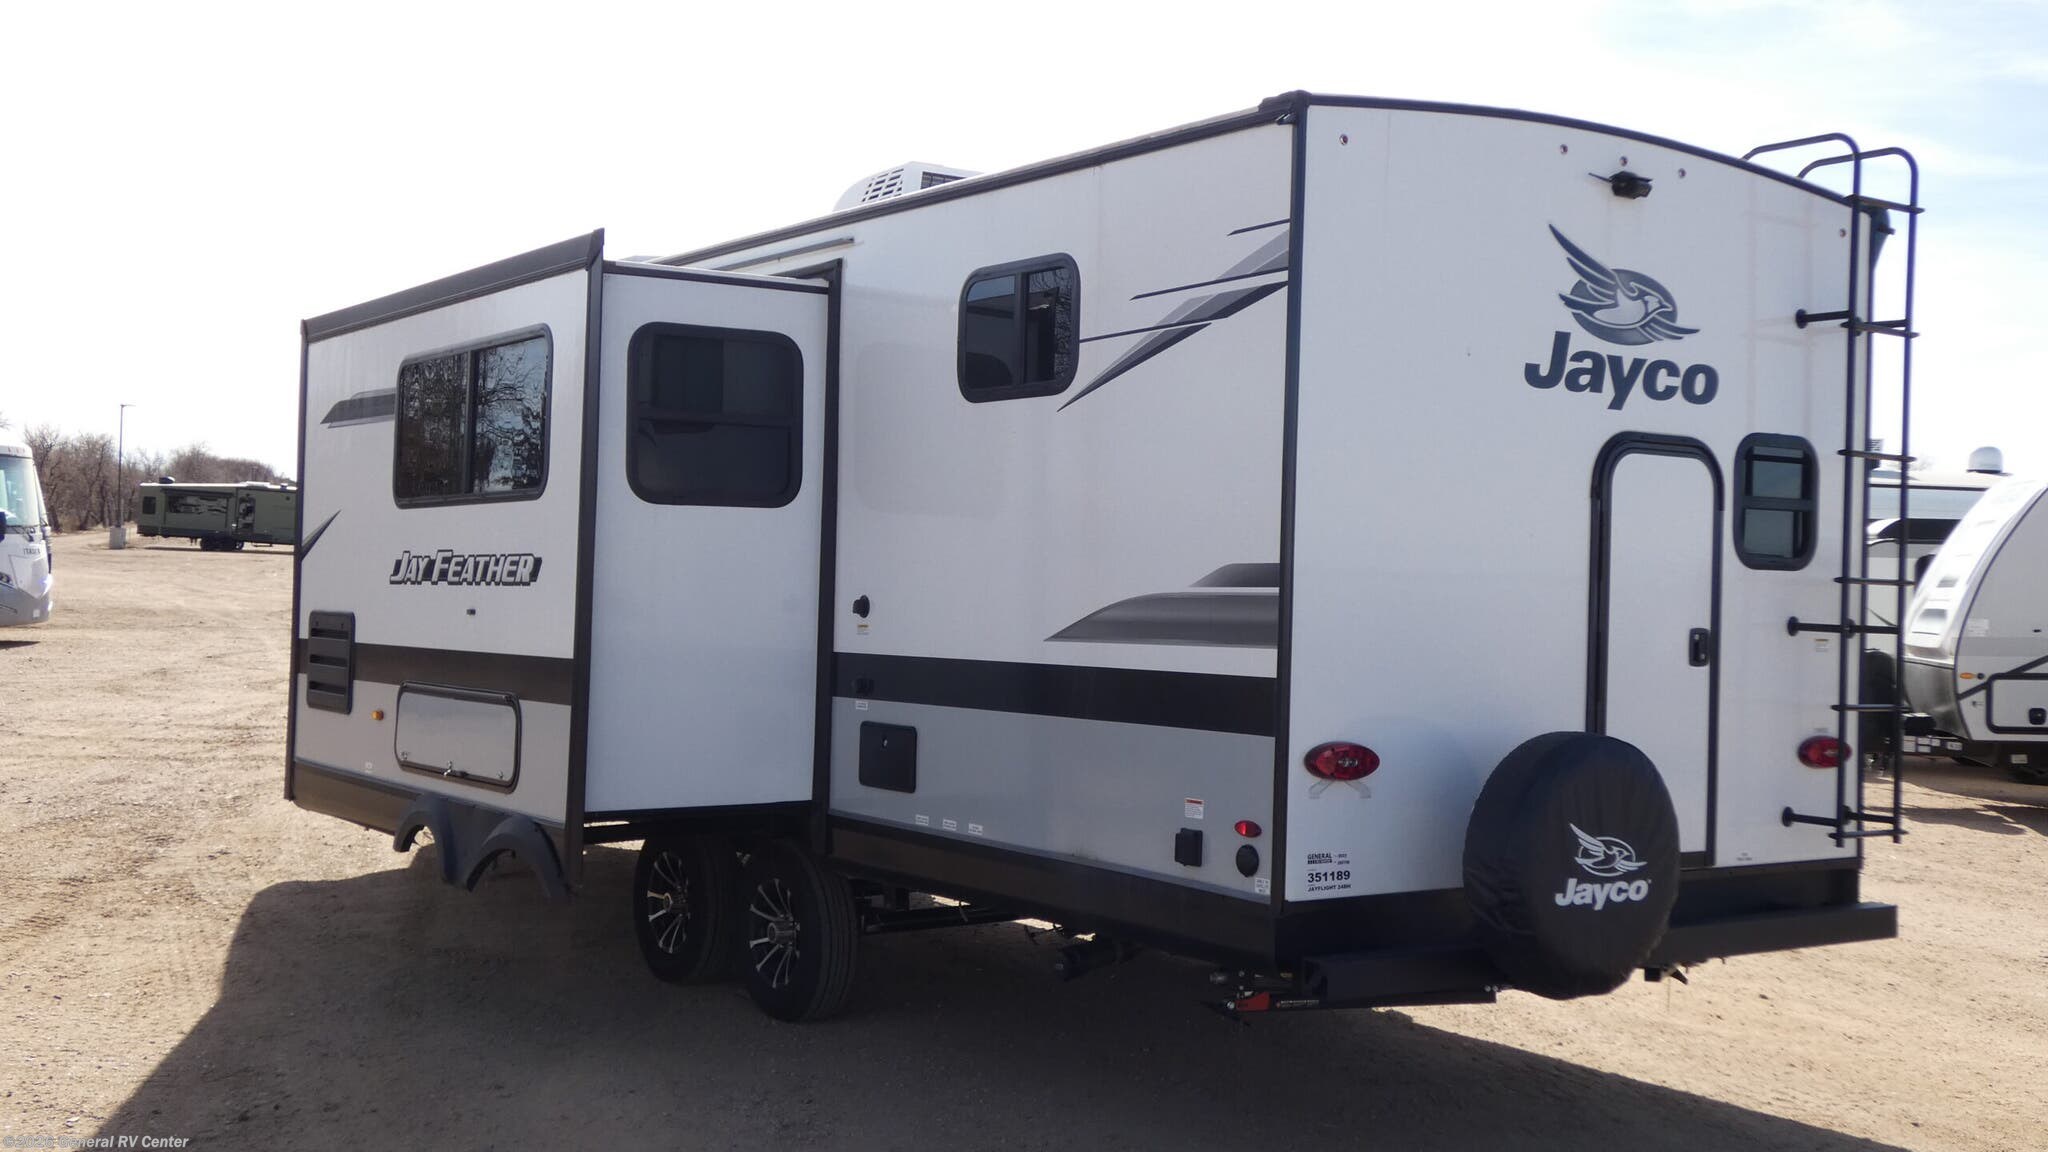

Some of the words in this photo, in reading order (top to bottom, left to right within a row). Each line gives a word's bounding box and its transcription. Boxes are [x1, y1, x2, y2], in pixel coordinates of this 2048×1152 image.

[1524, 330, 1719, 411] Jayco
[389, 550, 431, 585] JAY
[431, 549, 541, 586] FEATHER
[1307, 852, 1332, 860] GENERAL
[1307, 870, 1351, 883] 351189
[1555, 878, 1649, 911] Jayco
